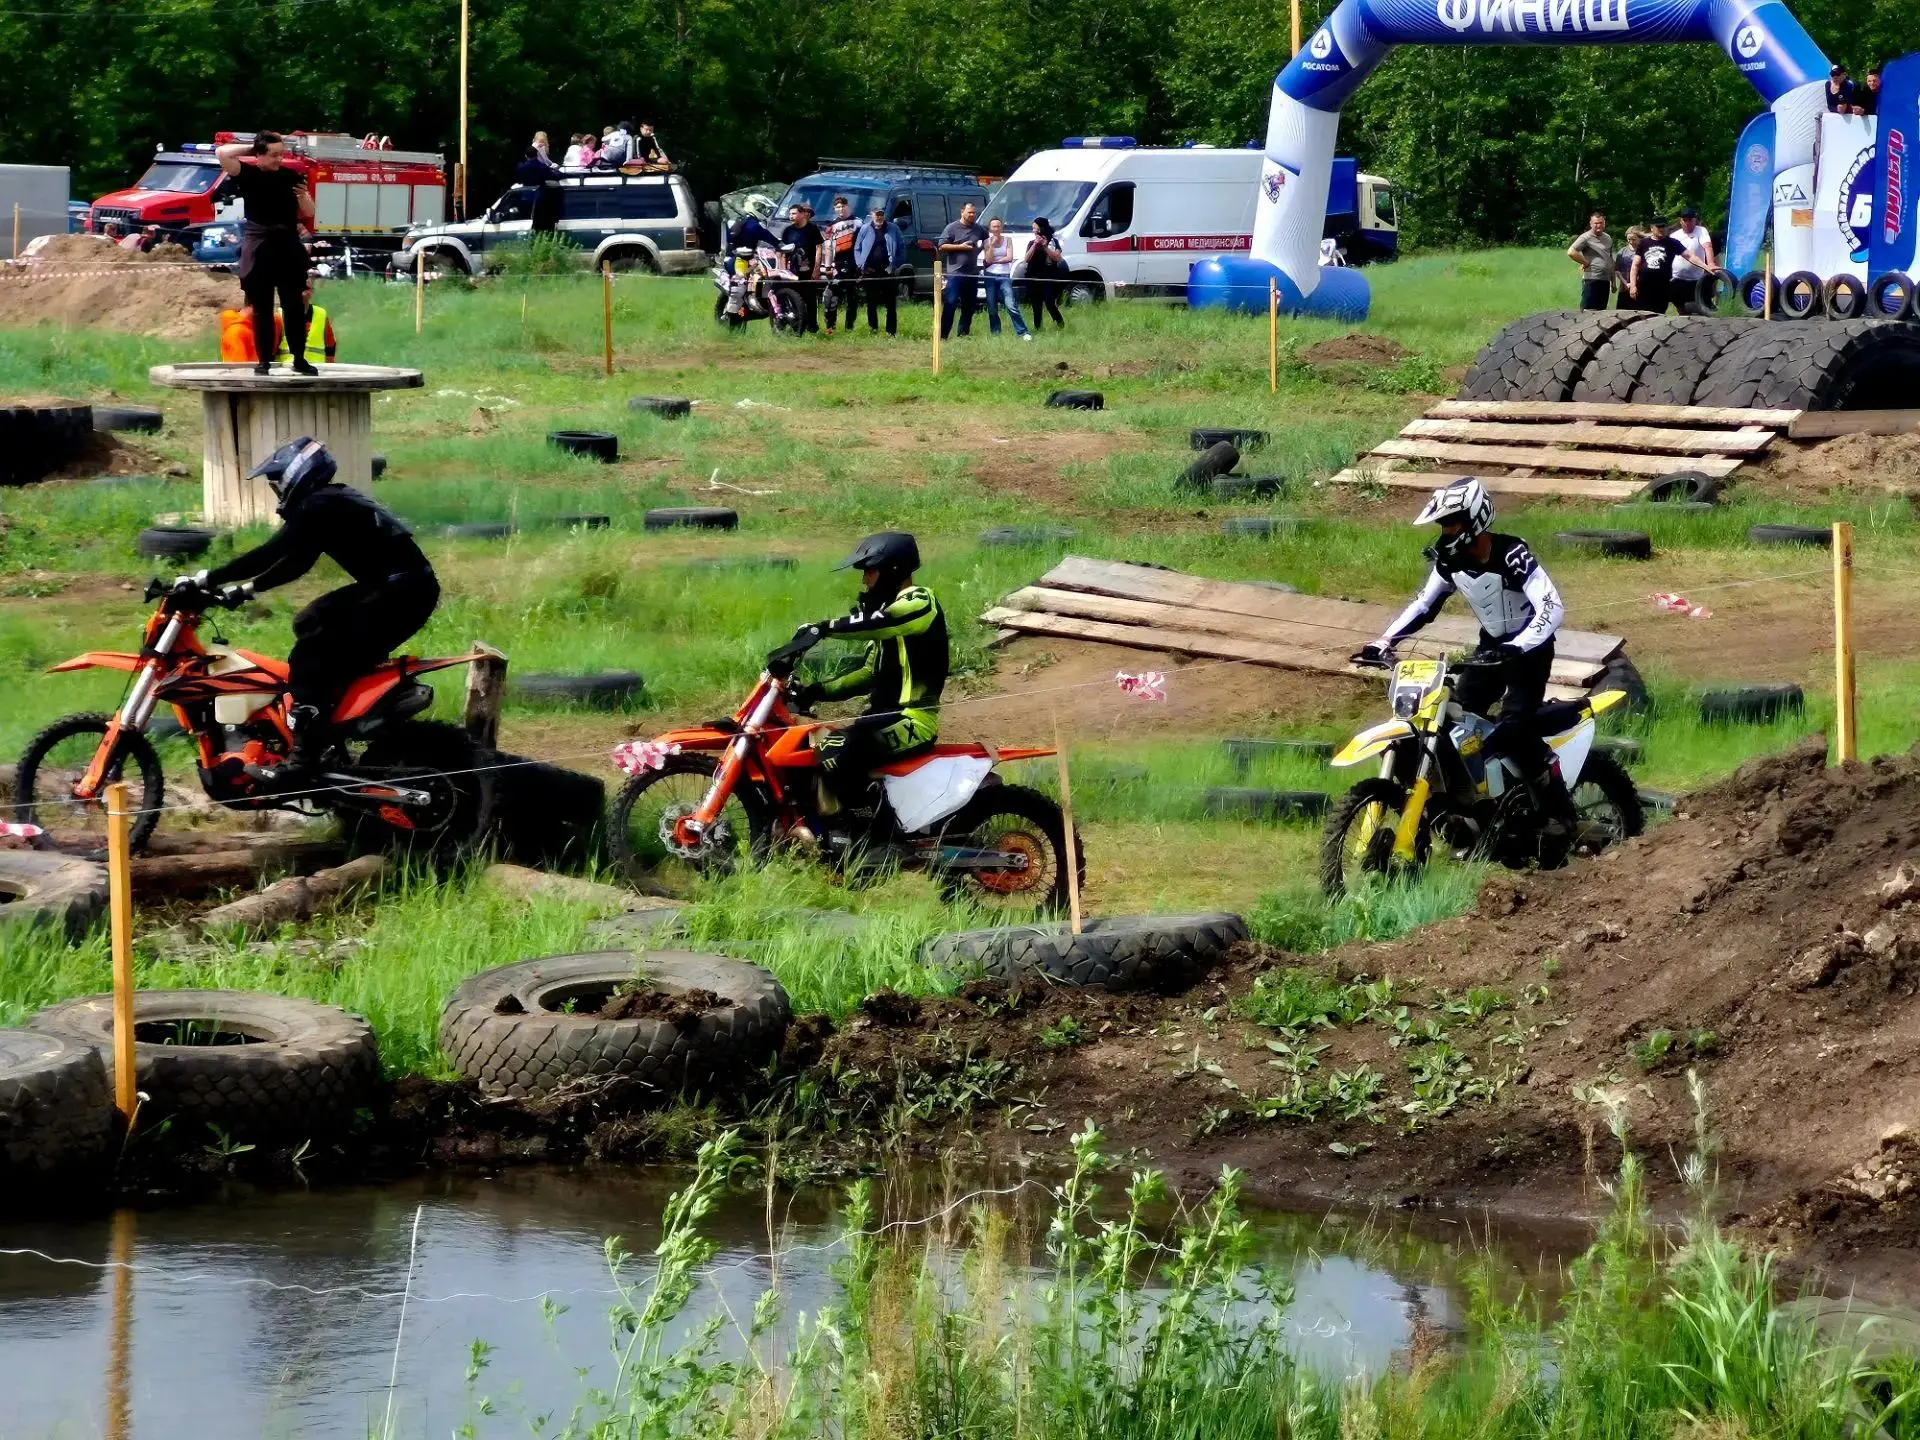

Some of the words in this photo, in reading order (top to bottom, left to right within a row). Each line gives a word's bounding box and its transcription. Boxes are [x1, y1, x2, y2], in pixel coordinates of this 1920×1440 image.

[1437, 0, 1630, 32] ФИНИШ
[1302, 61, 1340, 71] РОСАТОМ
[1154, 238, 1185, 249] СКОРАЯ
[1188, 237, 1245, 249] МЕДИЦИНСКАЯ
